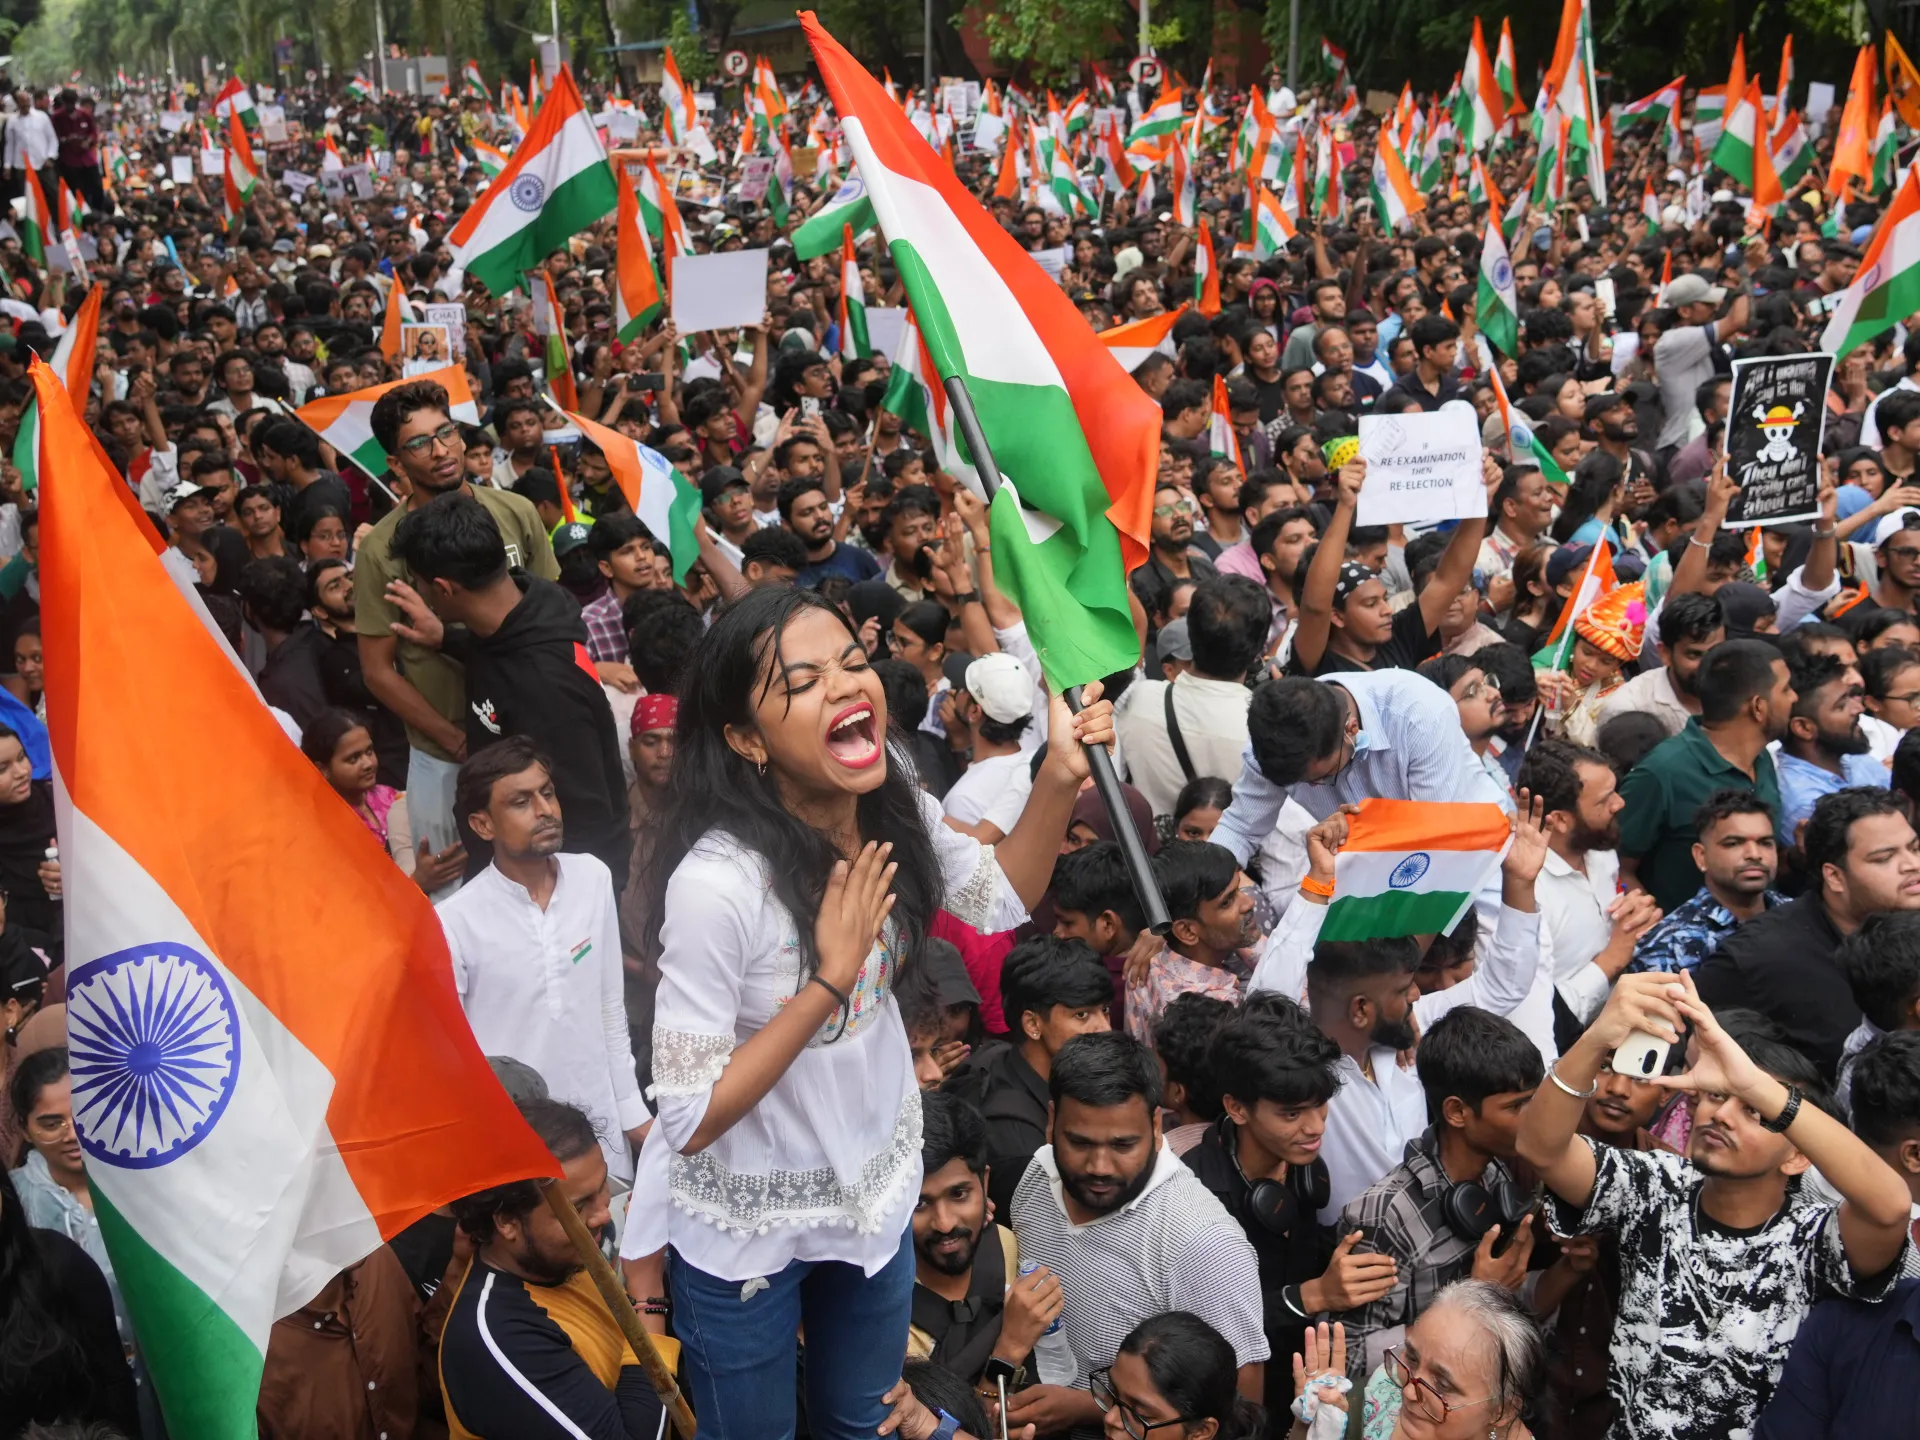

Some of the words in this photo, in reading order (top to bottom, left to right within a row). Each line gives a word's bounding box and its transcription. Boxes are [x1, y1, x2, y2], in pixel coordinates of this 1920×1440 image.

[732, 55, 743, 71] P
[1141, 63, 1157, 81] P
[432, 311, 457, 320] CHAI
[1422, 442, 1430, 450] IF
[1380, 452, 1466, 466] RE-EXAMINATION
[1411, 467, 1433, 476] THEN
[1740, 460, 1778, 488] They
[1389, 478, 1454, 491] RE-ELECTION
[1742, 495, 1786, 519] about
